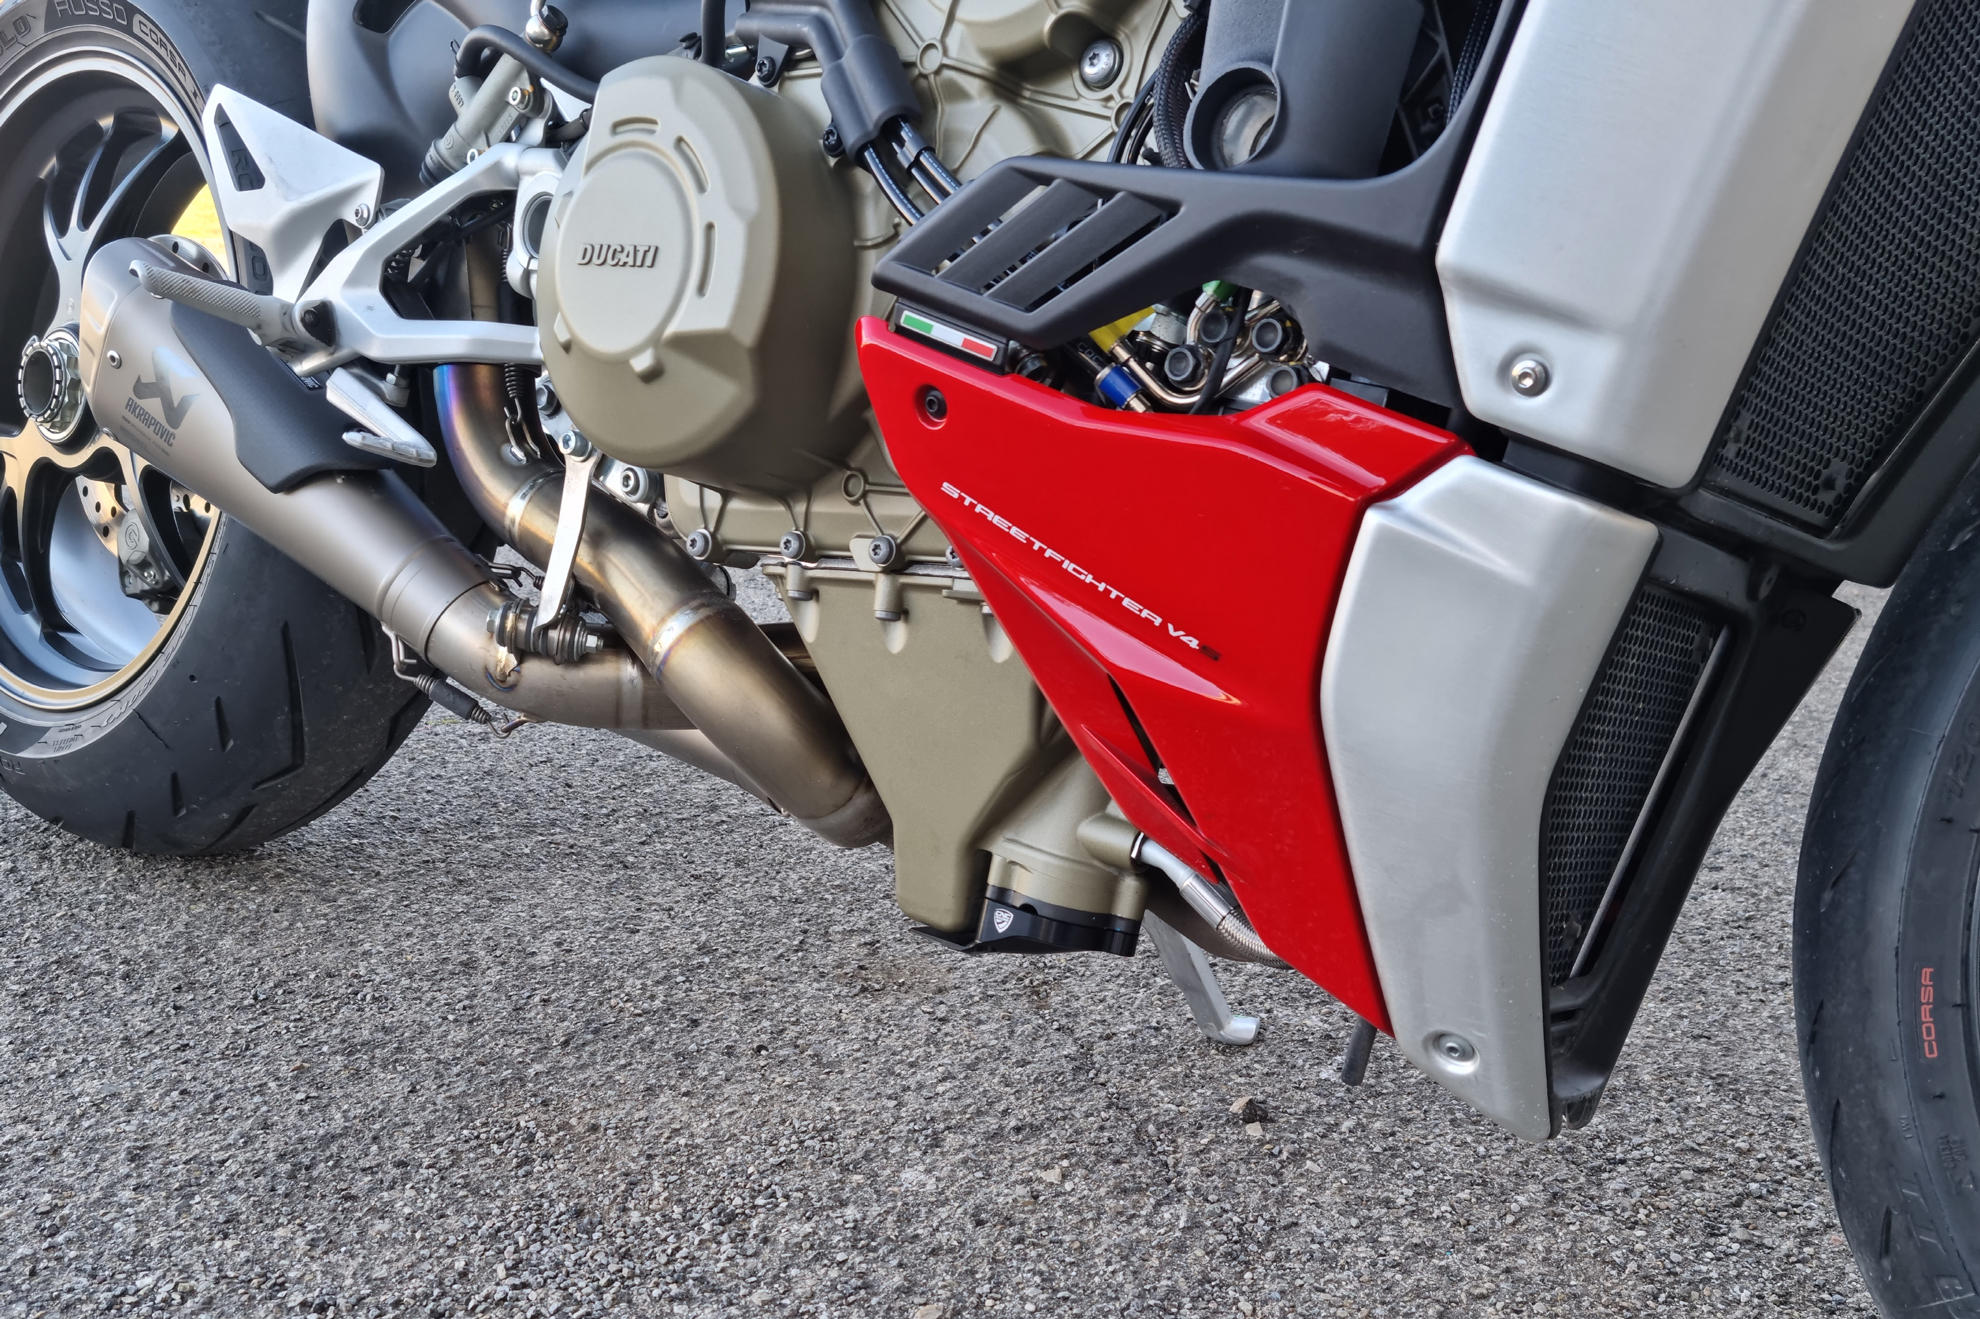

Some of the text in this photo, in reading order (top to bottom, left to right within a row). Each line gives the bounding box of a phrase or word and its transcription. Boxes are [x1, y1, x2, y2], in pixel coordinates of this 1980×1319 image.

[54, 0, 128, 25] ROSSO
[138, 19, 187, 81] CORSA
[576, 243, 660, 269] DUCATI
[940, 481, 1163, 627] STREETFIGHTER
[1920, 967, 1938, 1059] CORSA
